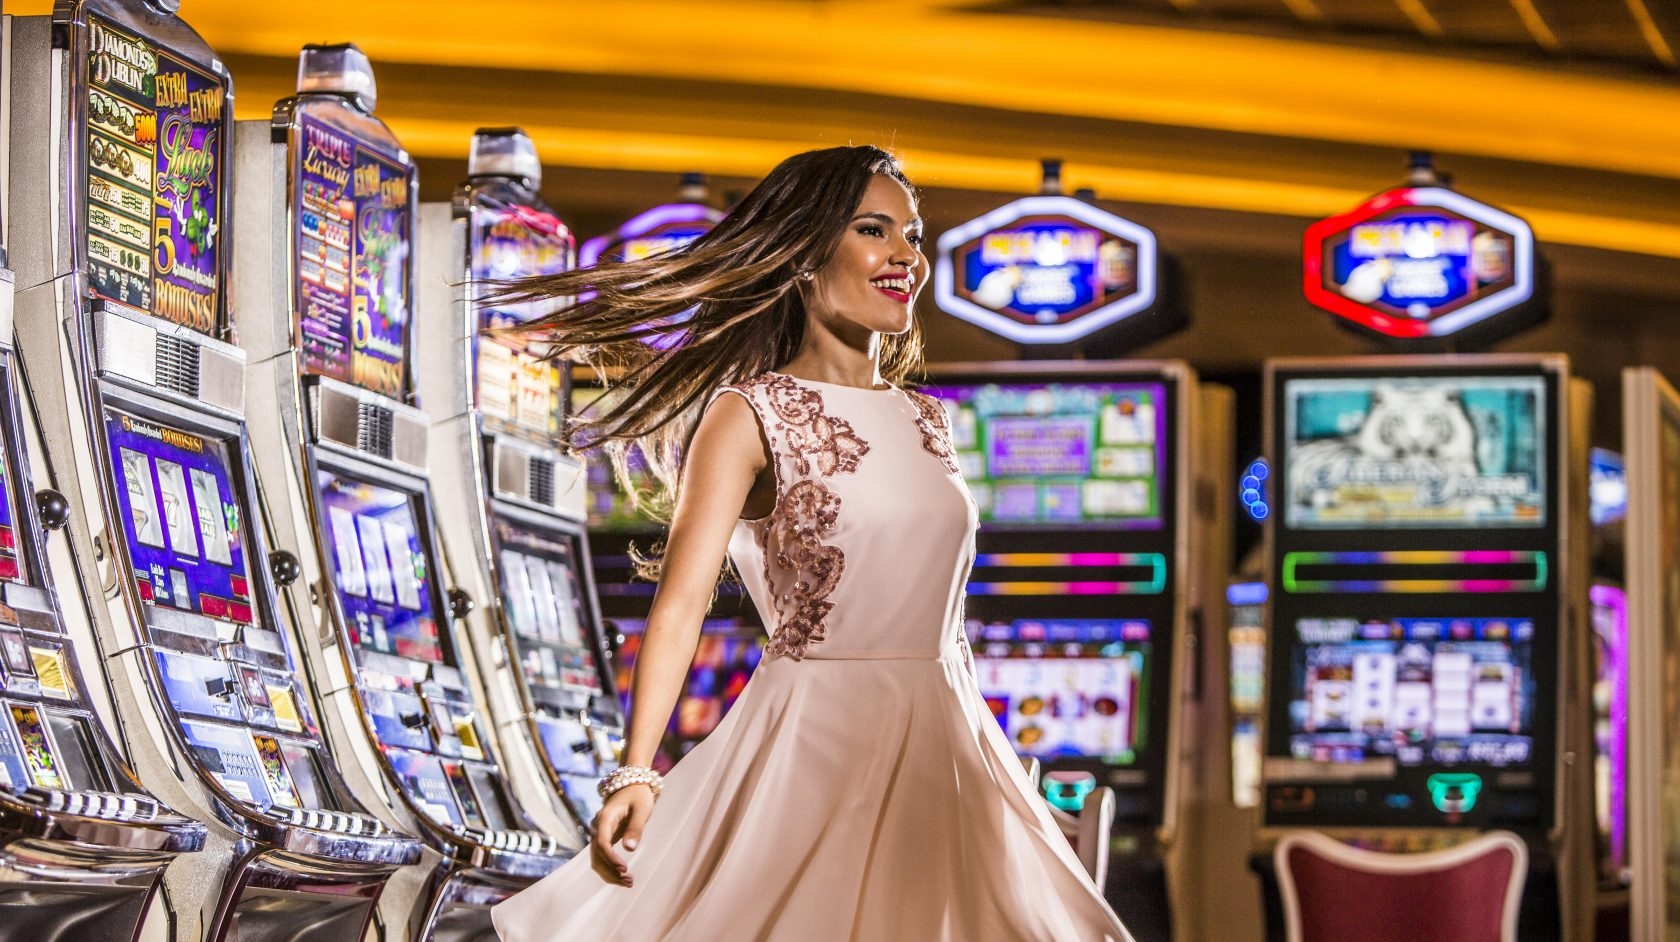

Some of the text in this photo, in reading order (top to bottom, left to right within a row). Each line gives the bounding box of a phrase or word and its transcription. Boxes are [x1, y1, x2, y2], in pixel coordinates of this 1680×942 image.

[89, 22, 149, 72] DIAMONDS
[95, 52, 144, 92] DUBLIN
[155, 72, 225, 124] EXTRA EXTRA
[134, 112, 156, 145] 5000
[156, 113, 216, 200] Luck
[154, 217, 176, 275] 5
[154, 278, 216, 336] BONUSES!
